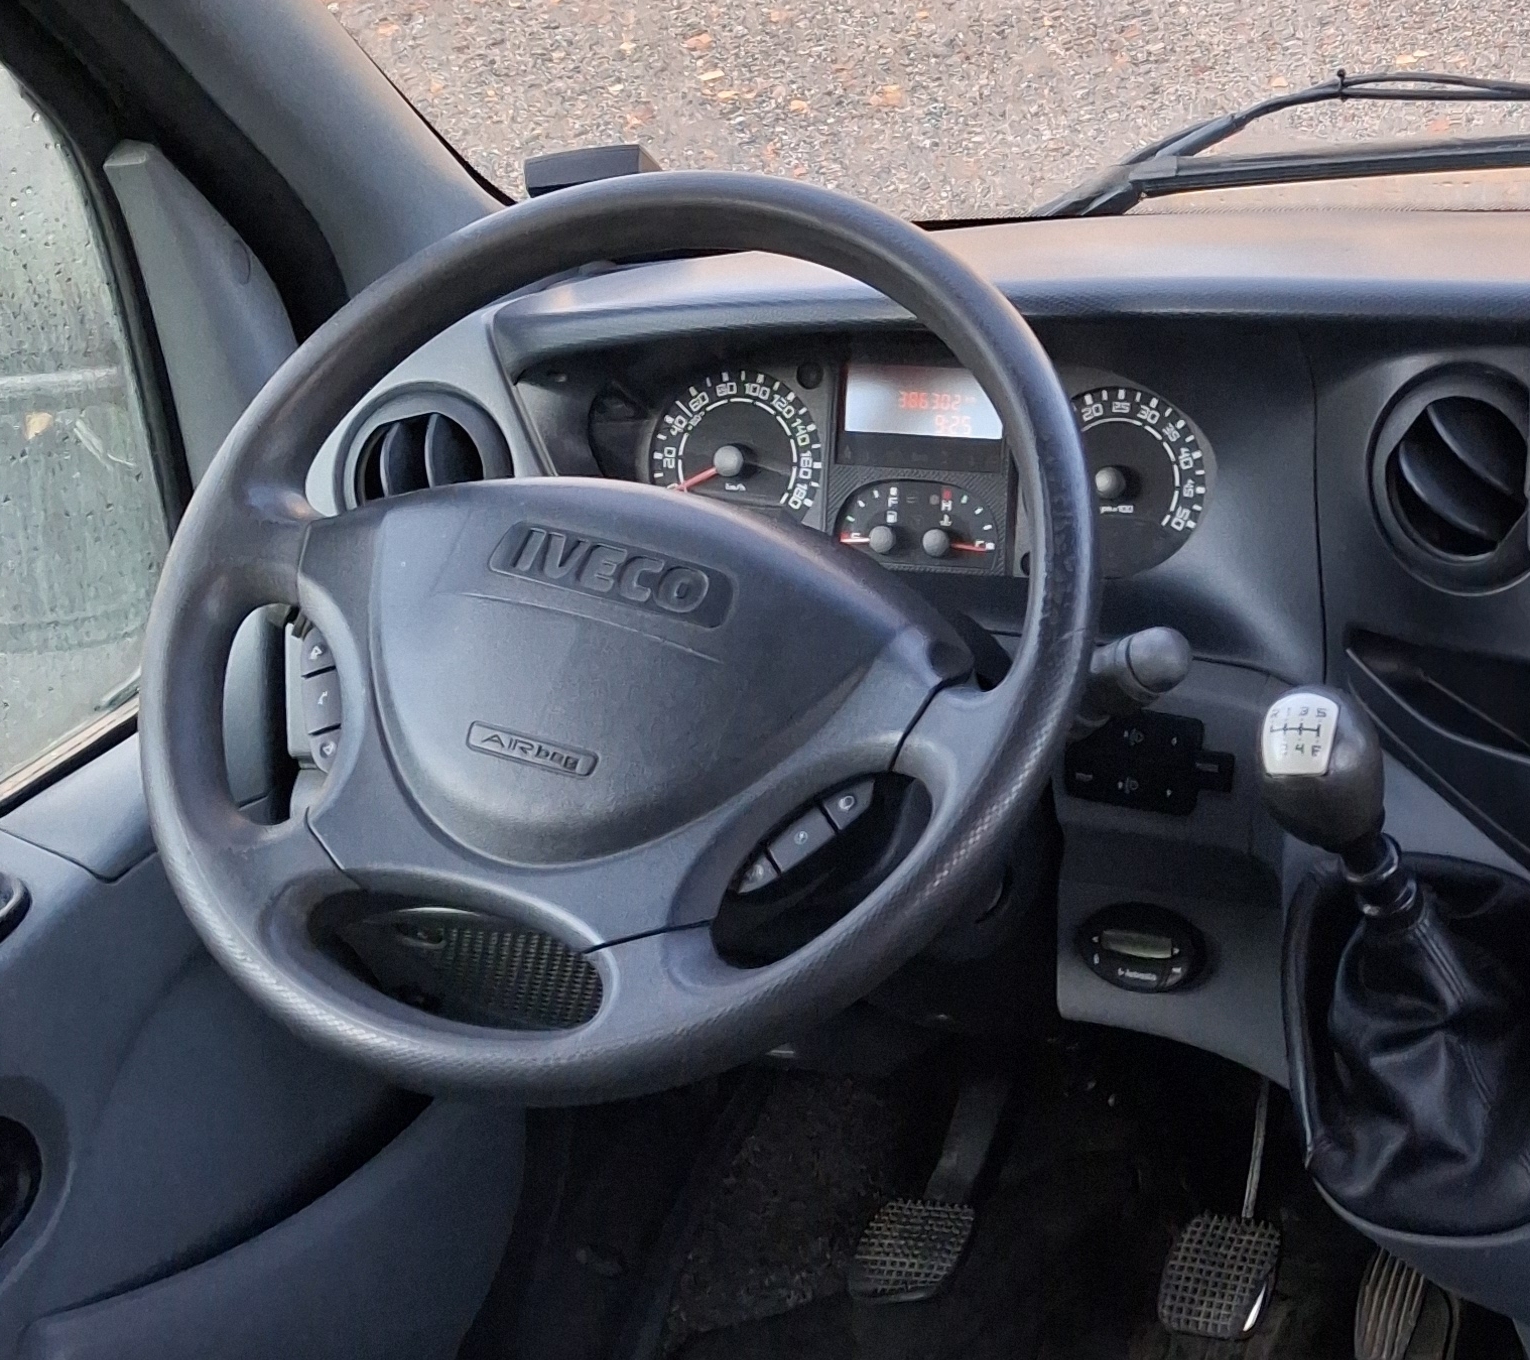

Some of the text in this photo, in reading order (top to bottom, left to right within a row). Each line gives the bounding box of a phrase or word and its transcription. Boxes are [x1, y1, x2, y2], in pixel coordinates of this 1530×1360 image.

[744, 383, 770, 400] 100
[689, 392, 709, 412] 60
[770, 395, 794, 419] 120
[1112, 401, 1130, 413] 25
[1081, 403, 1103, 422] 20
[1137, 404, 1160, 424] 30
[670, 415, 687, 435] 40
[791, 418, 810, 446] 140
[1162, 423, 1180, 442] 35
[663, 447, 676, 468] 20
[799, 451, 813, 475] 160
[1178, 447, 1193, 469] 40
[788, 483, 808, 510] 180
[888, 497, 898, 508] F
[941, 500, 953, 511] H
[1171, 506, 1190, 531] 50
[514, 527, 710, 613] IVECO
[1298, 706, 1309, 716] 3
[1316, 708, 1327, 718] 5
[1295, 743, 1305, 754] 4
